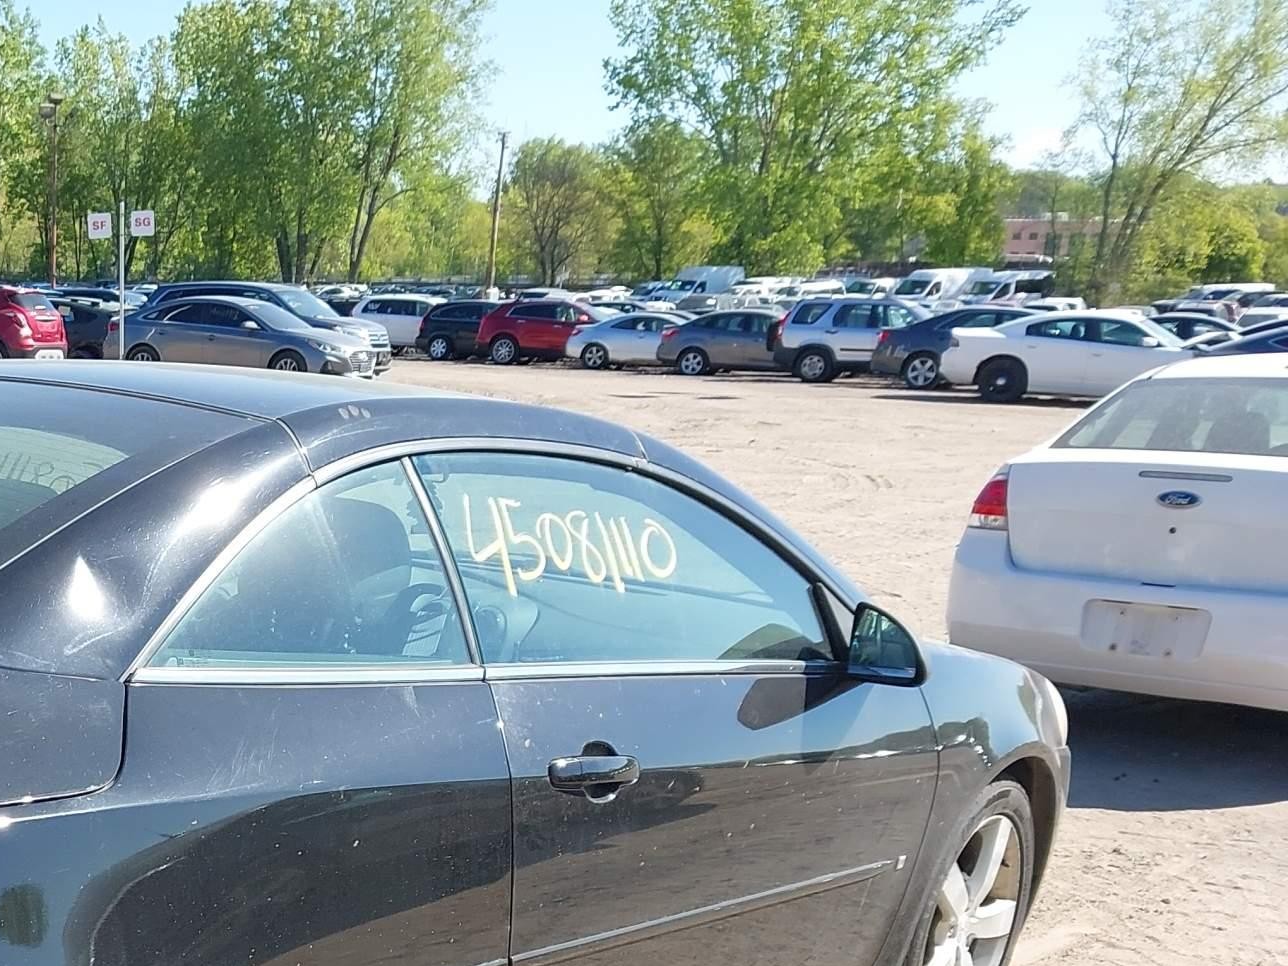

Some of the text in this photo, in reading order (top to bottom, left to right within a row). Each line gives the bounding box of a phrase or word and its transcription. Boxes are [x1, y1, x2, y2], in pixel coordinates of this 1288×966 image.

[92, 220, 107, 231] SF
[134, 217, 151, 227] SG
[462, 493, 678, 598] 45081110
